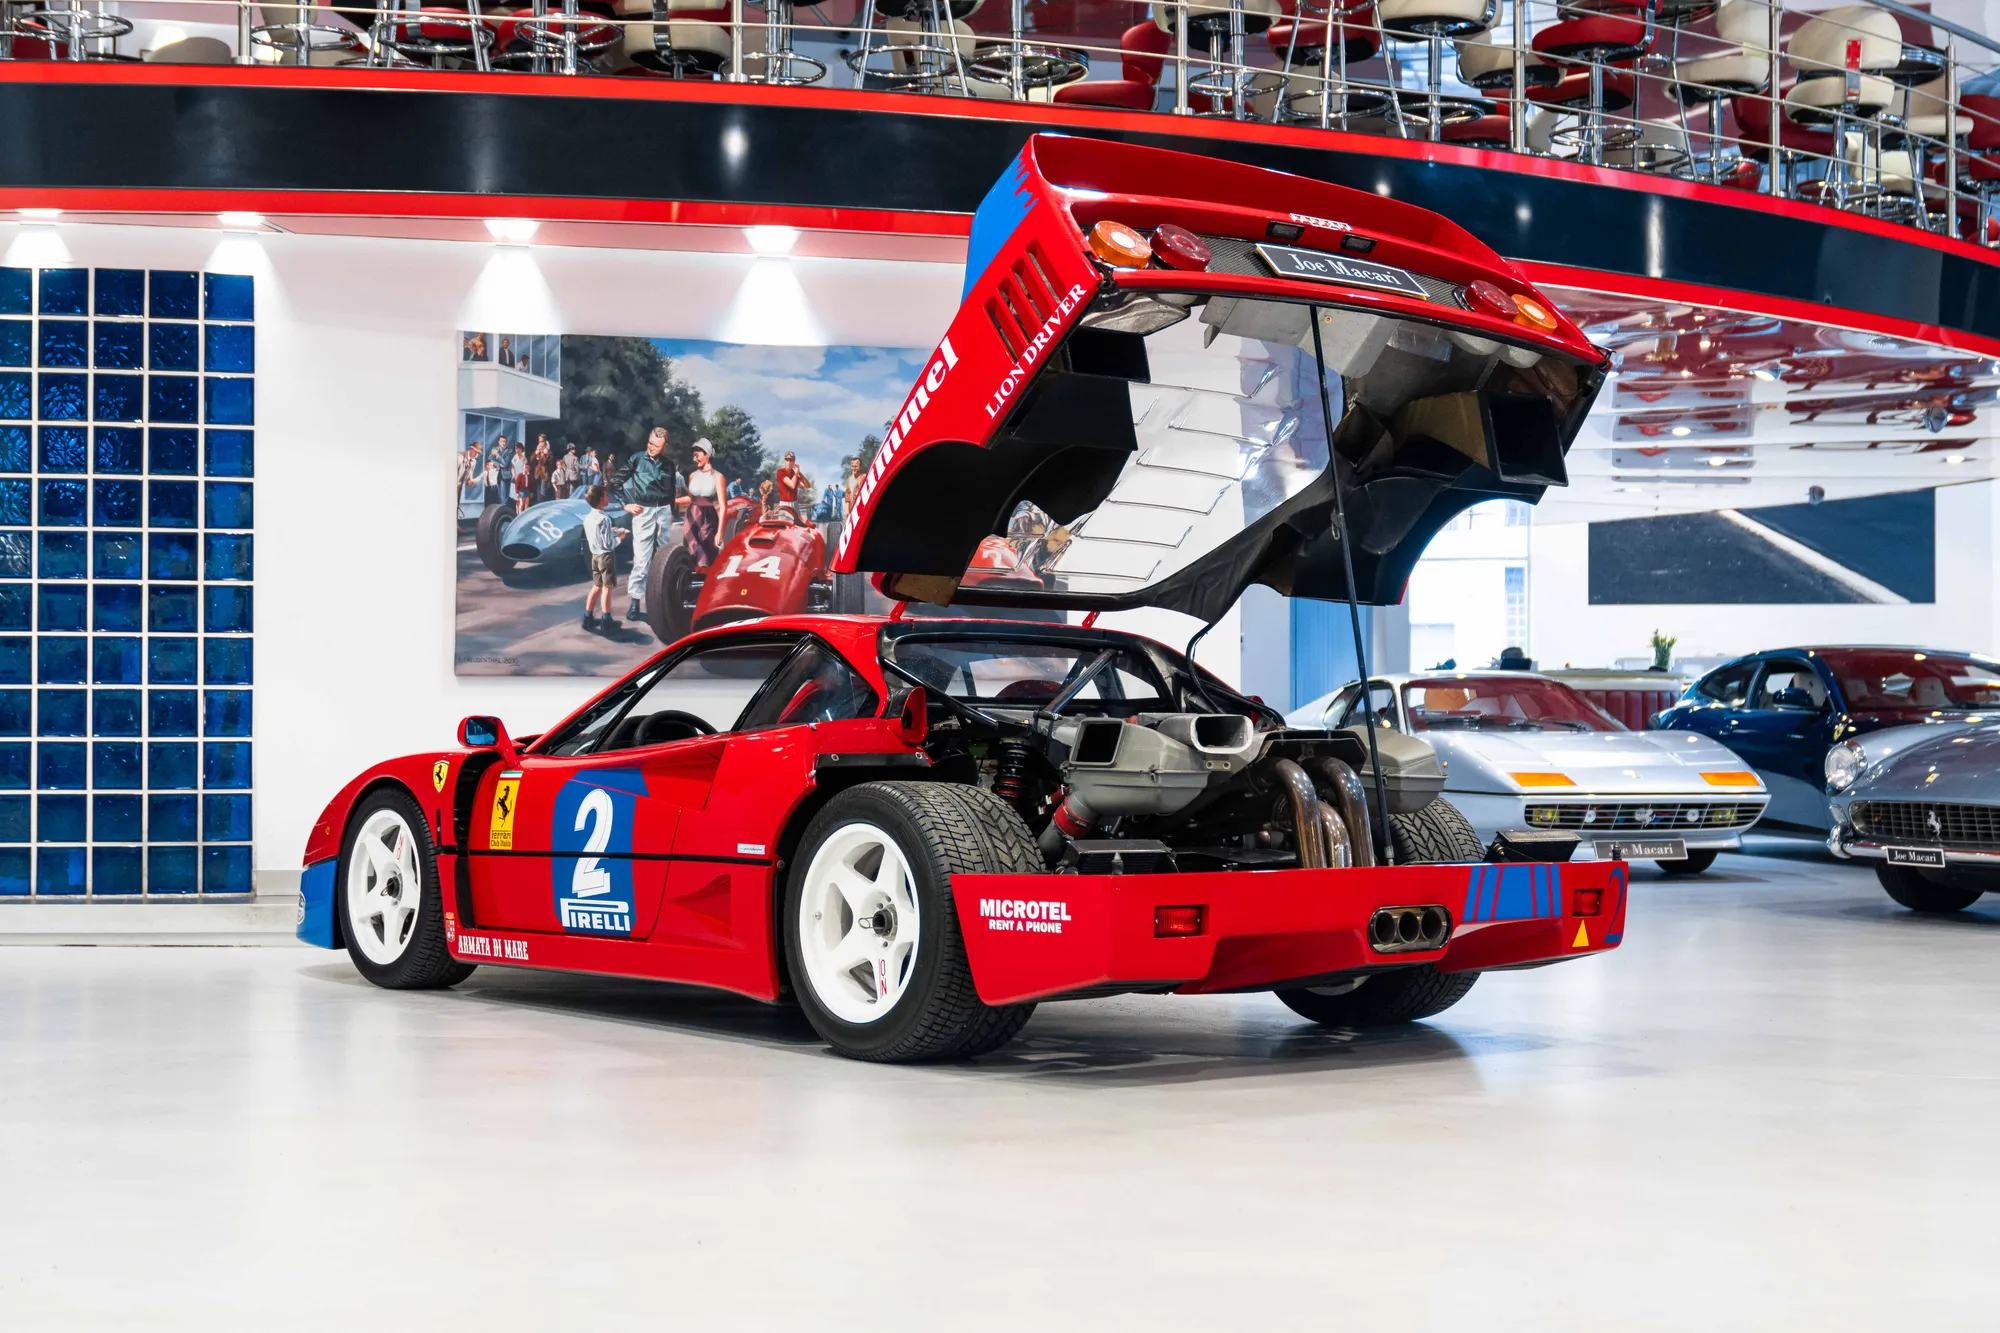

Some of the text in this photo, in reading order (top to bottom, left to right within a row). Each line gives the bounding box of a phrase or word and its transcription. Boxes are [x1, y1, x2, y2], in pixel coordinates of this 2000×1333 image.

[1288, 253, 1402, 285] Joe Macari
[984, 284, 1087, 419] LION DRIVER
[532, 520, 563, 541] 18
[717, 554, 781, 580] 14
[491, 829, 511, 840] Ferrari
[571, 788, 614, 898] 2
[1631, 843, 1674, 855] Macari
[1894, 850, 1937, 863] Joe Macari
[560, 898, 630, 931] PIRELLI
[980, 898, 1072, 921] MICROTEL
[988, 919, 1062, 934] RENT A PHONE
[458, 935, 529, 960] ARMATA DI MARE
